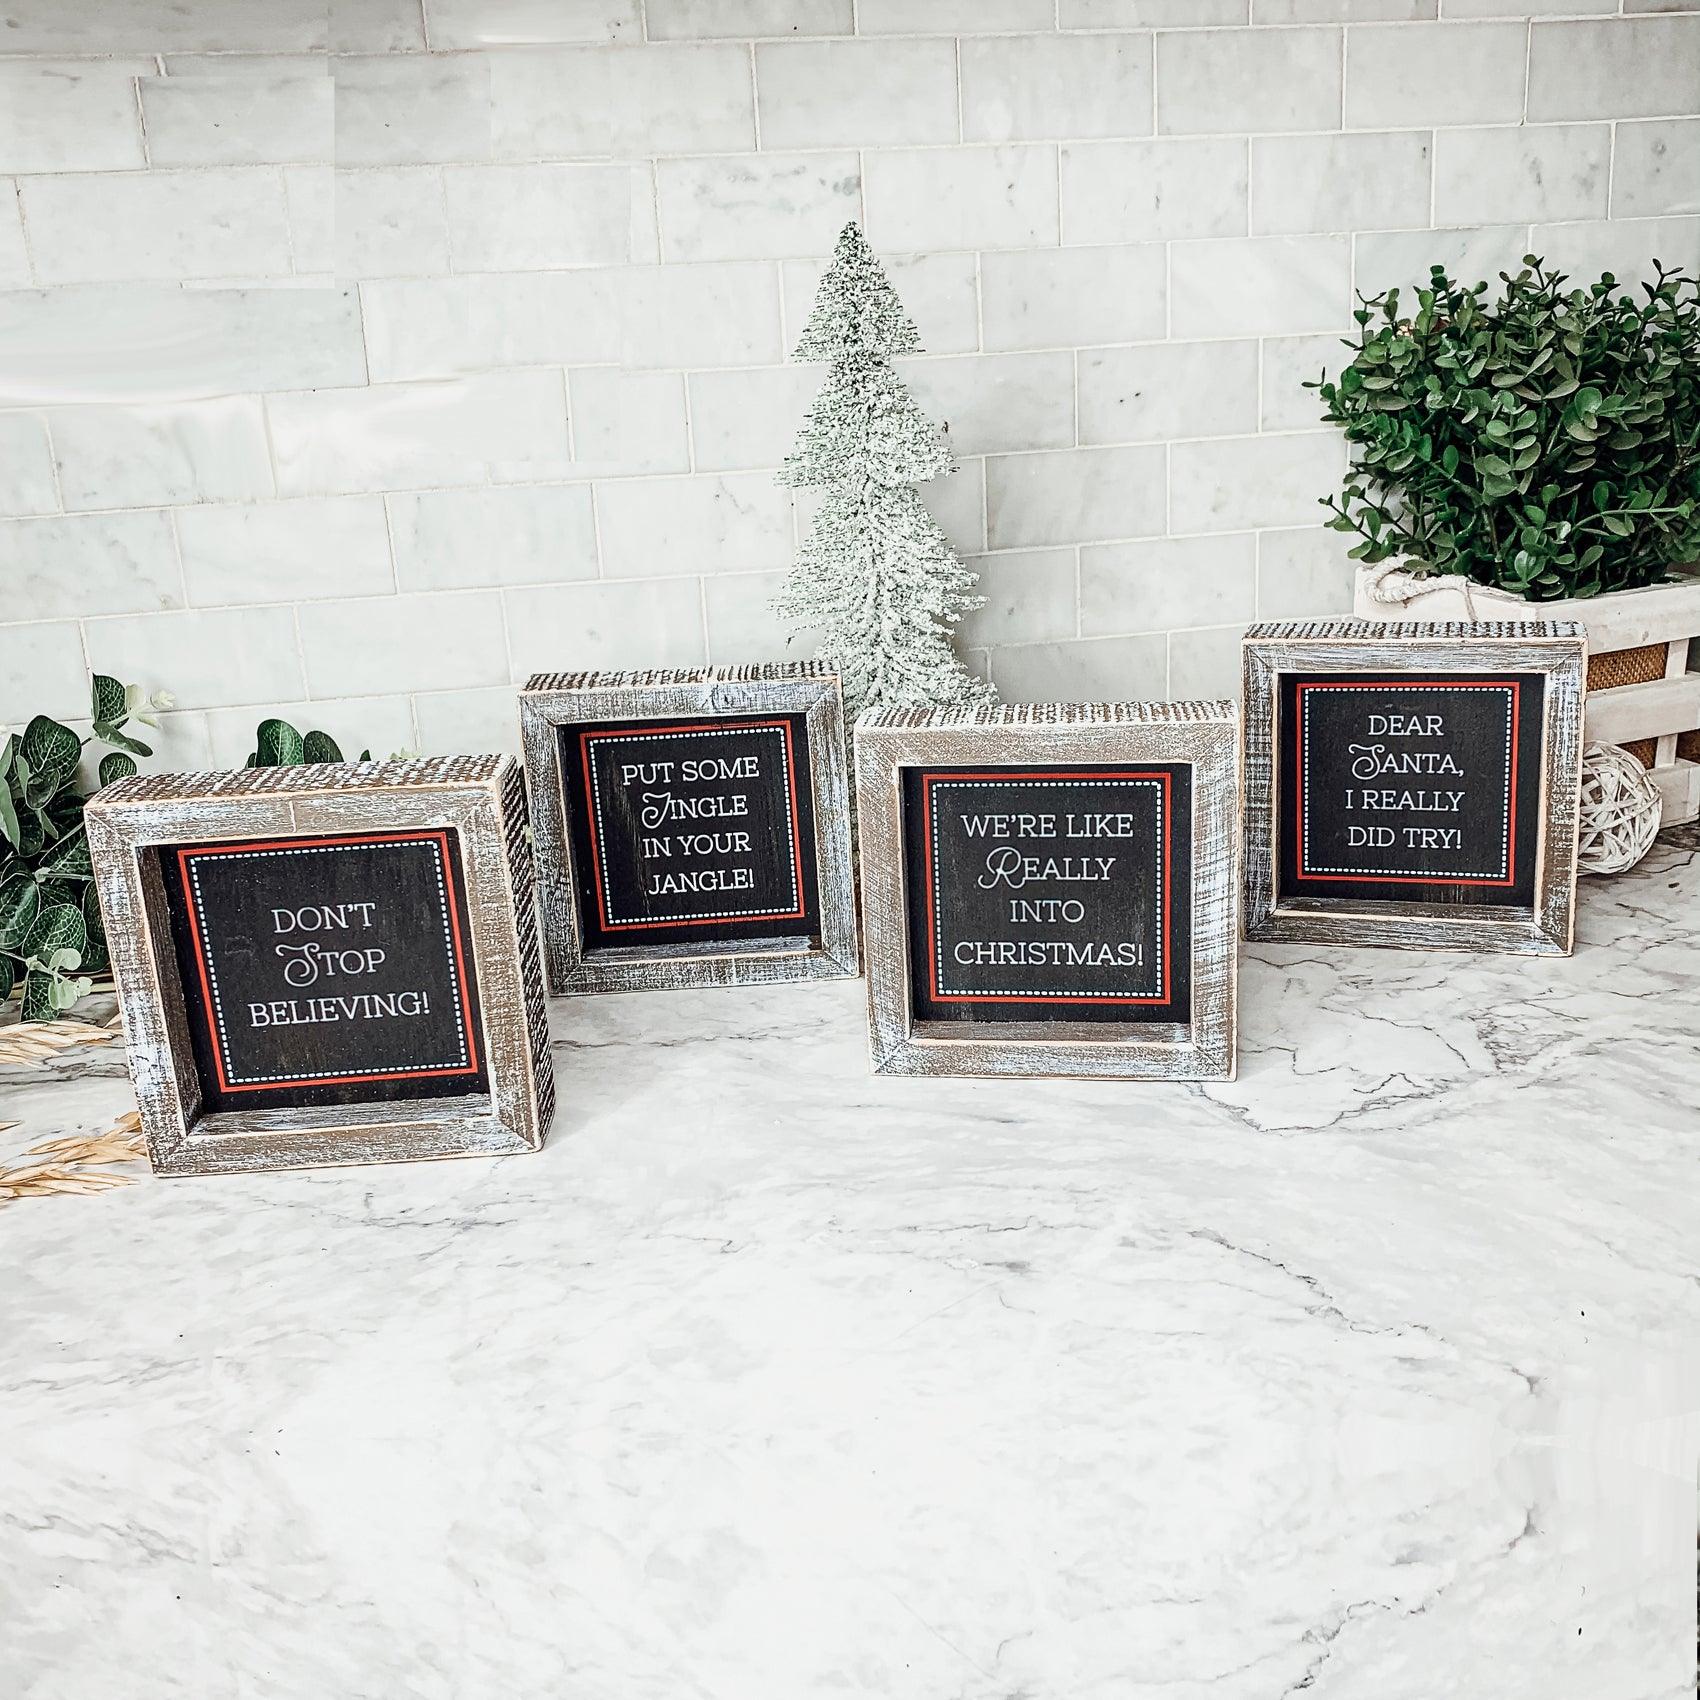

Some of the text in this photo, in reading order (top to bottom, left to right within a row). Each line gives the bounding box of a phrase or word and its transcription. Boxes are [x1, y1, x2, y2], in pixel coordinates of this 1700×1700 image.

[1368, 714, 1444, 737] DEAR
[621, 756, 760, 786] PUT SOME
[1348, 744, 1464, 781] SANTA,
[641, 791, 748, 830] JINGLE
[1345, 789, 1465, 812] I REALLY
[960, 814, 1133, 838] WE'RE LIKE
[1348, 826, 1462, 850] DID TRY!
[642, 832, 752, 859] IN YOUR
[648, 868, 755, 895] JANGLE!
[977, 846, 1116, 890] REALLY
[271, 901, 376, 935] DON'T
[1009, 900, 1085, 924] INTO
[275, 942, 386, 988] STOP
[954, 941, 1144, 966] CHRISTMAS!
[248, 991, 430, 1028] BELIEVING!
